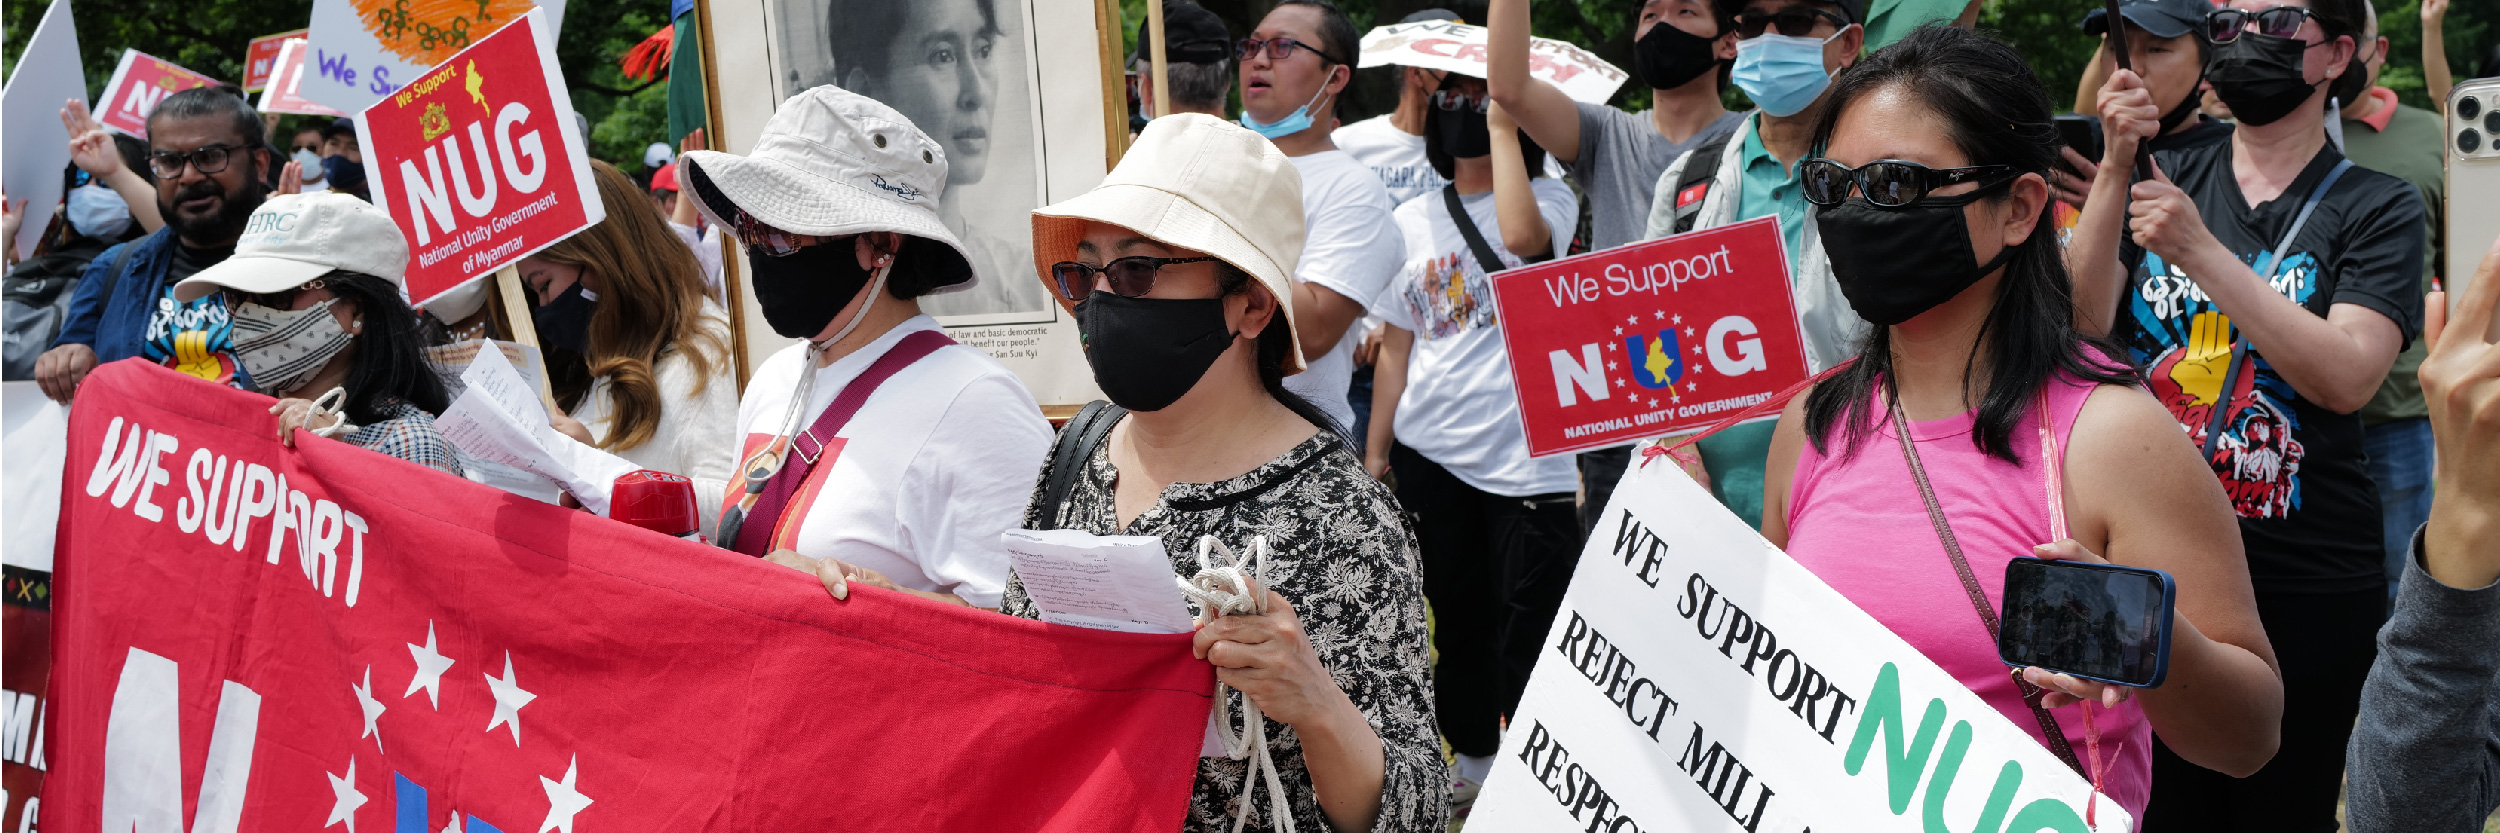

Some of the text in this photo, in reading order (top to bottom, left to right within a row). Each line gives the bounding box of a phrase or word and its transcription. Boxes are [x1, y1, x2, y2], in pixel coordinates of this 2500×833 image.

[318, 47, 357, 87] We
[396, 63, 458, 109] We Support
[399, 101, 547, 247] NUG
[419, 190, 559, 270] National Unity Government
[463, 233, 525, 275] of Myanmar
[1544, 244, 1733, 308] We Support
[958, 330, 971, 339] law
[973, 329, 986, 338] and
[988, 328, 1006, 338] basic
[1008, 326, 1048, 337] democratic
[995, 350, 1008, 359] San
[1009, 349, 1023, 358] Suu
[1025, 349, 1038, 360] Kyi
[997, 340, 1009, 348] our
[1564, 391, 1773, 439] NATIONAL UNITY GOVERNMENT
[86, 416, 178, 523] WE
[1612, 508, 1669, 589] WE
[1676, 573, 1857, 745] SUPPORT
[1556, 610, 1776, 833] REJECT MILI
